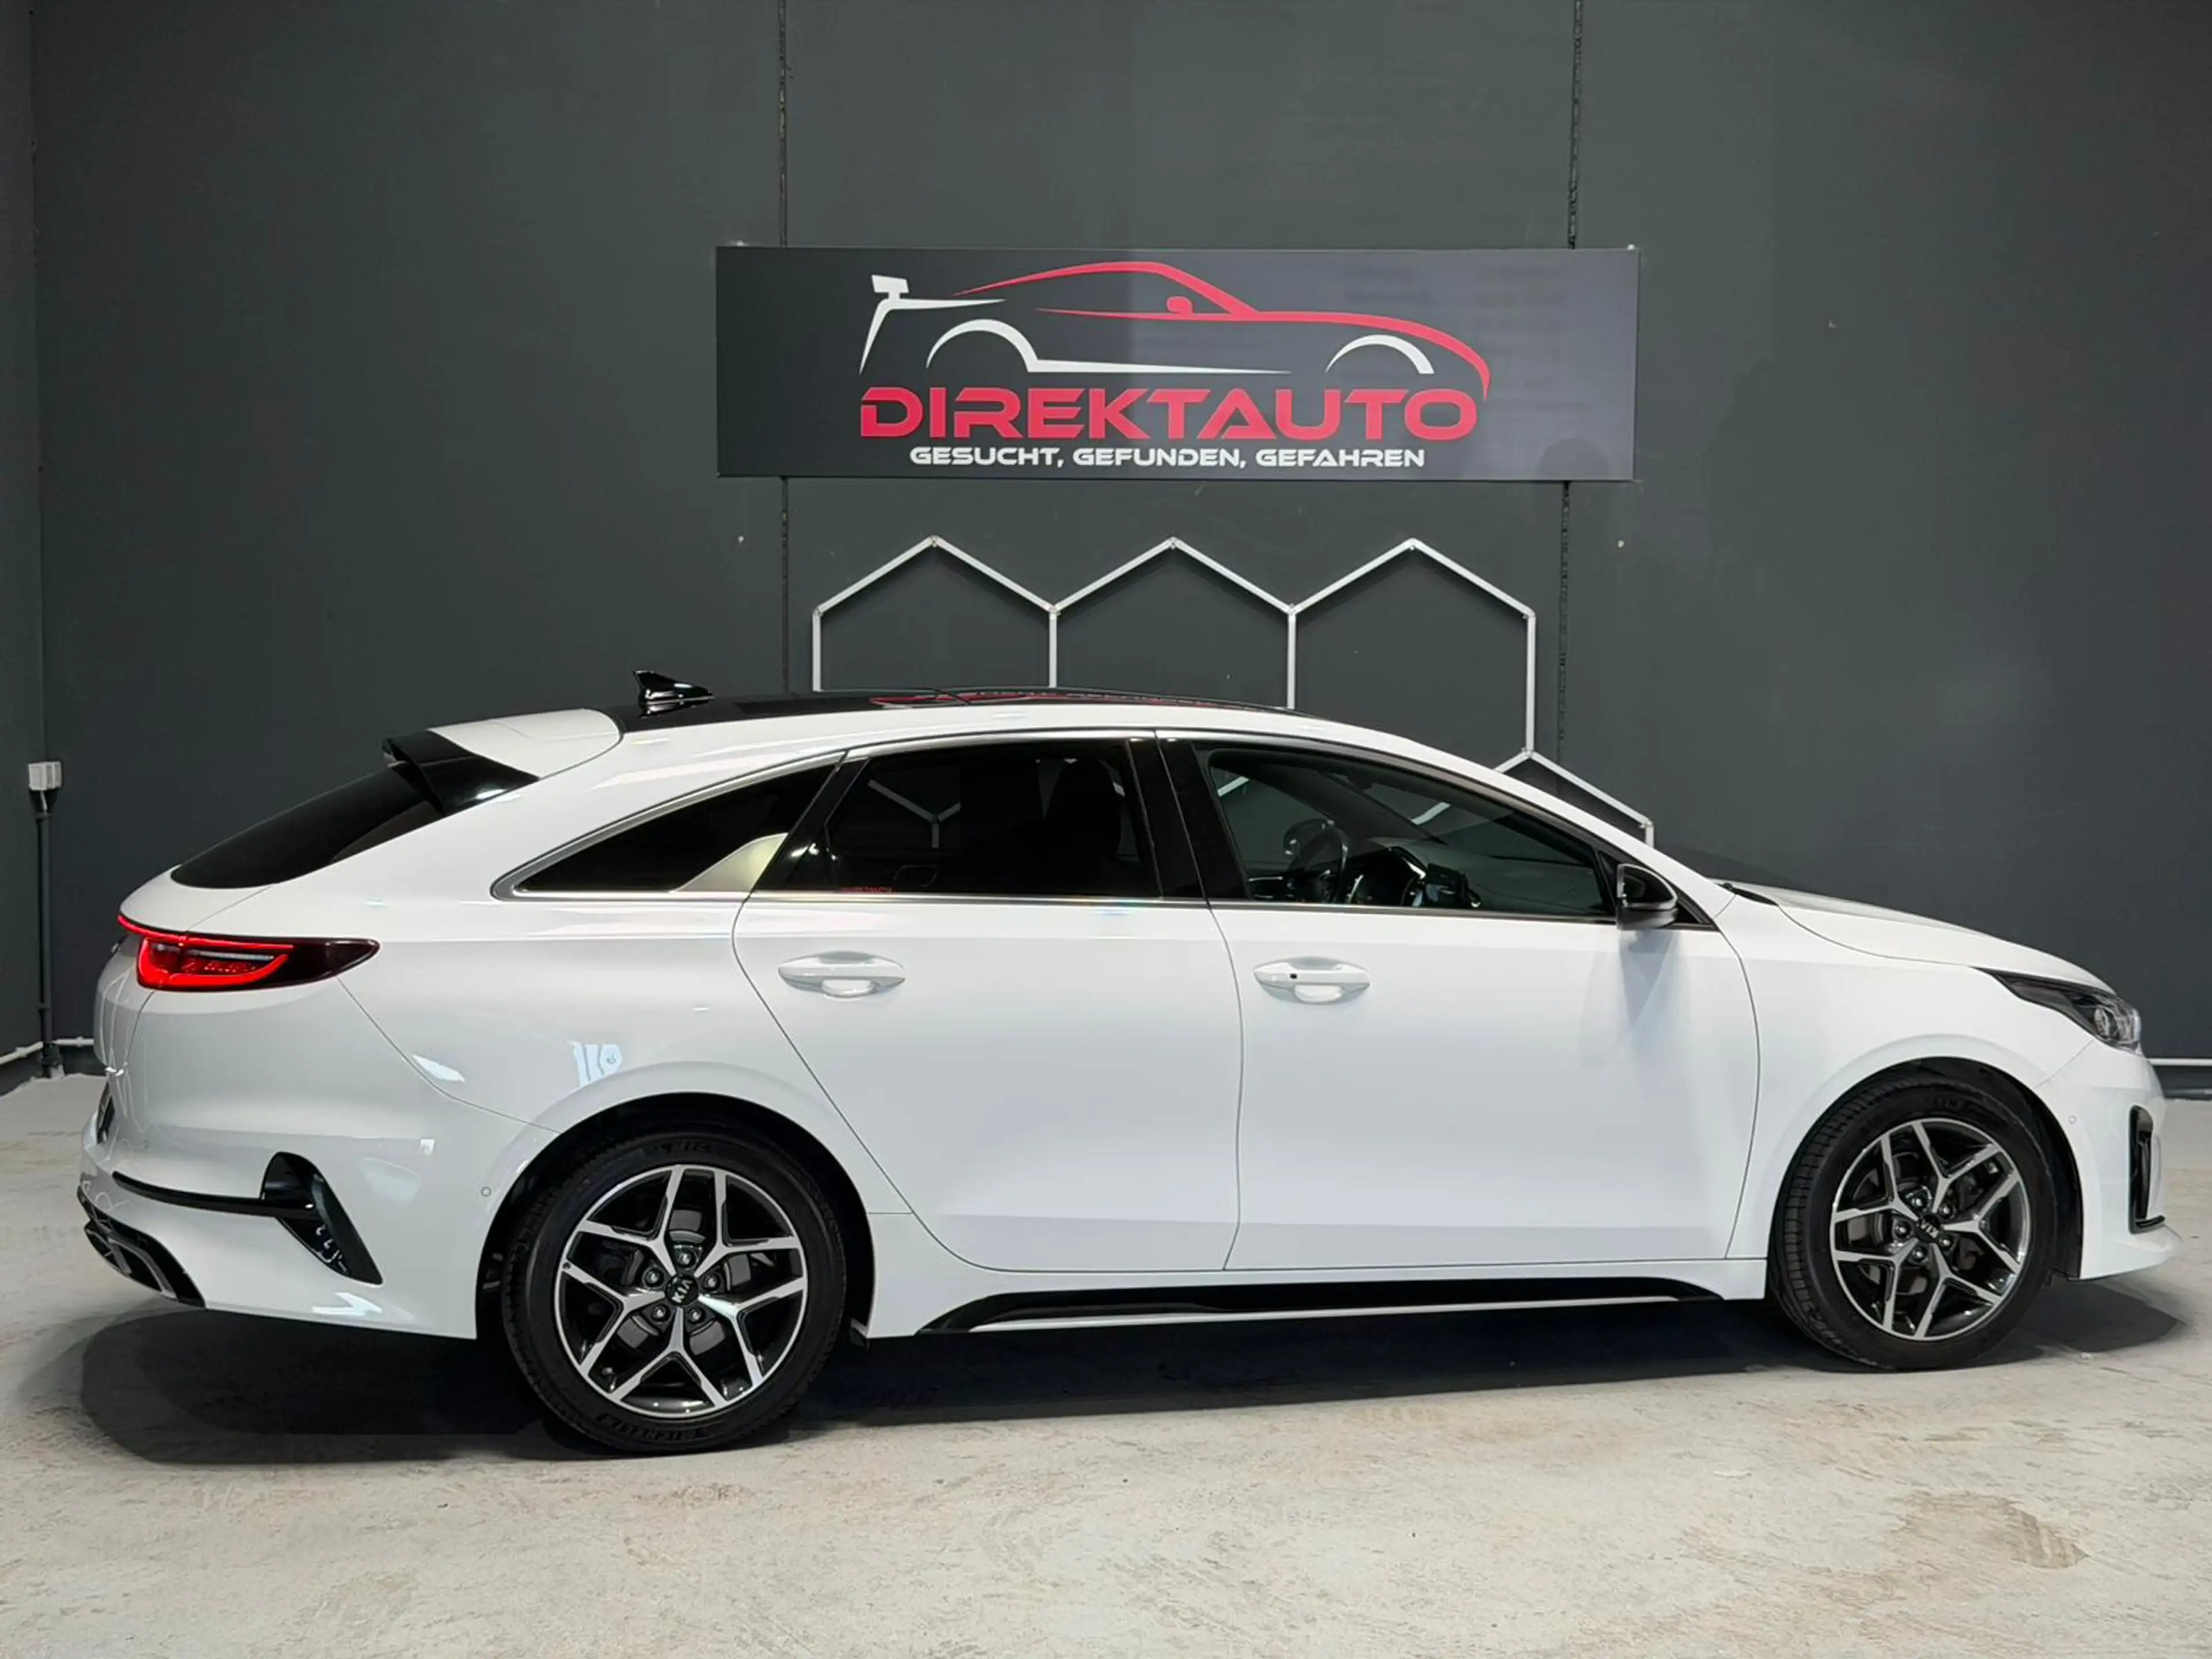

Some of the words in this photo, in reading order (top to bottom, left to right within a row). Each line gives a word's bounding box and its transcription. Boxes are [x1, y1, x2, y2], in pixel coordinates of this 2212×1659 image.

[861, 387, 1478, 441] DIREKTAUTO
[910, 446, 1065, 468] GESUCHT,
[1072, 447, 1247, 469] GEFUNDEN,
[1255, 448, 1425, 468] GEFAHREN
[672, 1279, 693, 1303] KIA
